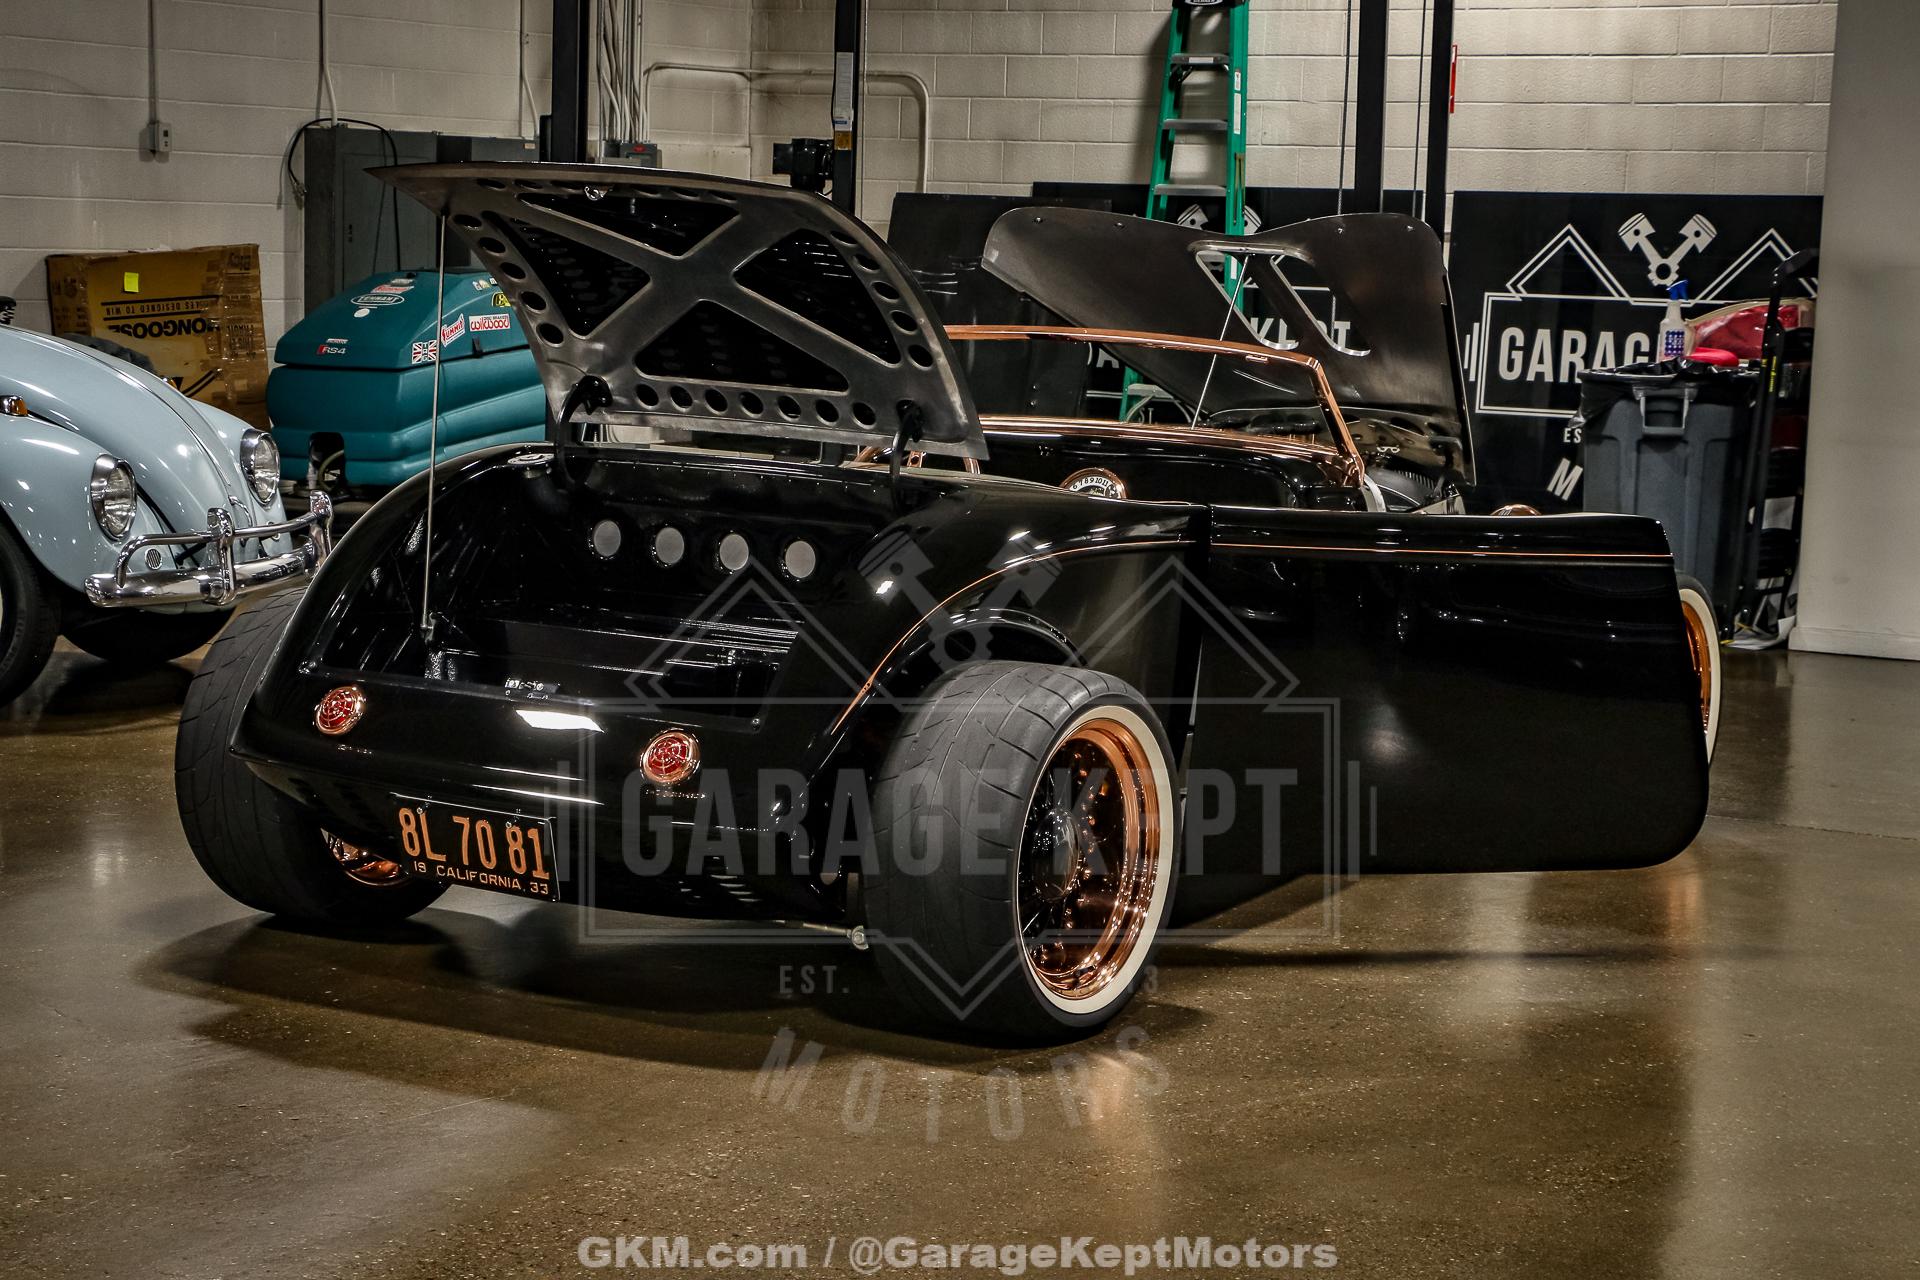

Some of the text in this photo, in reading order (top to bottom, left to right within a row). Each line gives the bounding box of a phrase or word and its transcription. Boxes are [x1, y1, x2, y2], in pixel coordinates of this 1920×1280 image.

[106, 306, 121, 316] WIN
[126, 305, 135, 314] TO
[322, 346, 346, 354] RS4
[1498, 327, 1661, 383] GARAG
[398, 807, 550, 880] 8L 70 81
[436, 865, 521, 890] CALIFORNIA
[530, 881, 549, 895] 33
